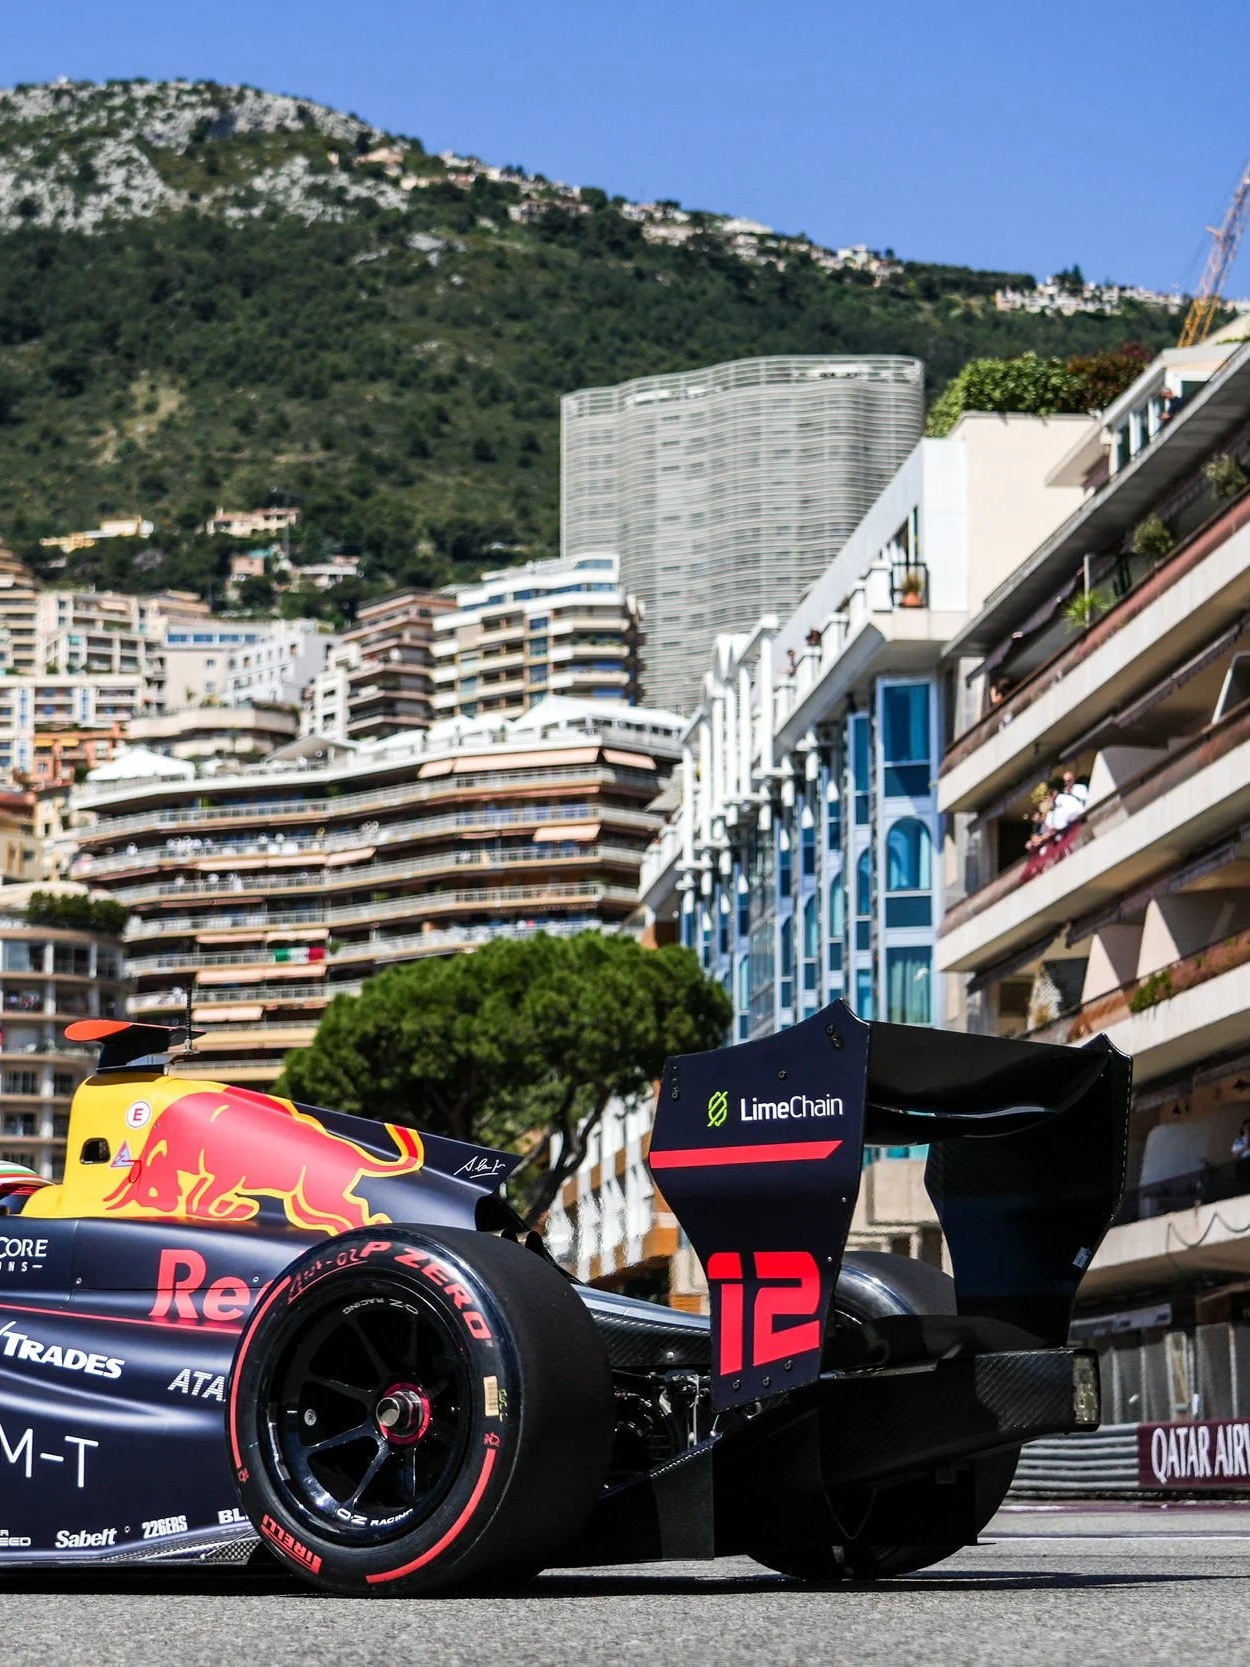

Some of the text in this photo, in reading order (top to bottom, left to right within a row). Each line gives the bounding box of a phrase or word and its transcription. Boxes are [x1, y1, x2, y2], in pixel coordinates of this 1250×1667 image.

[133, 1108, 144, 1121] E
[740, 1094, 844, 1122] LimeChain
[148, 1248, 273, 1321] Re
[359, 1241, 492, 1339] P ZERO
[707, 1251, 821, 1376] 12
[167, 1368, 227, 1402] ATA
[1151, 1422, 1250, 1484] QATAR AIR
[55, 1527, 118, 1549] Sabelt
[141, 1515, 188, 1540] 226ERS
[261, 1514, 323, 1575] PIRELLI
